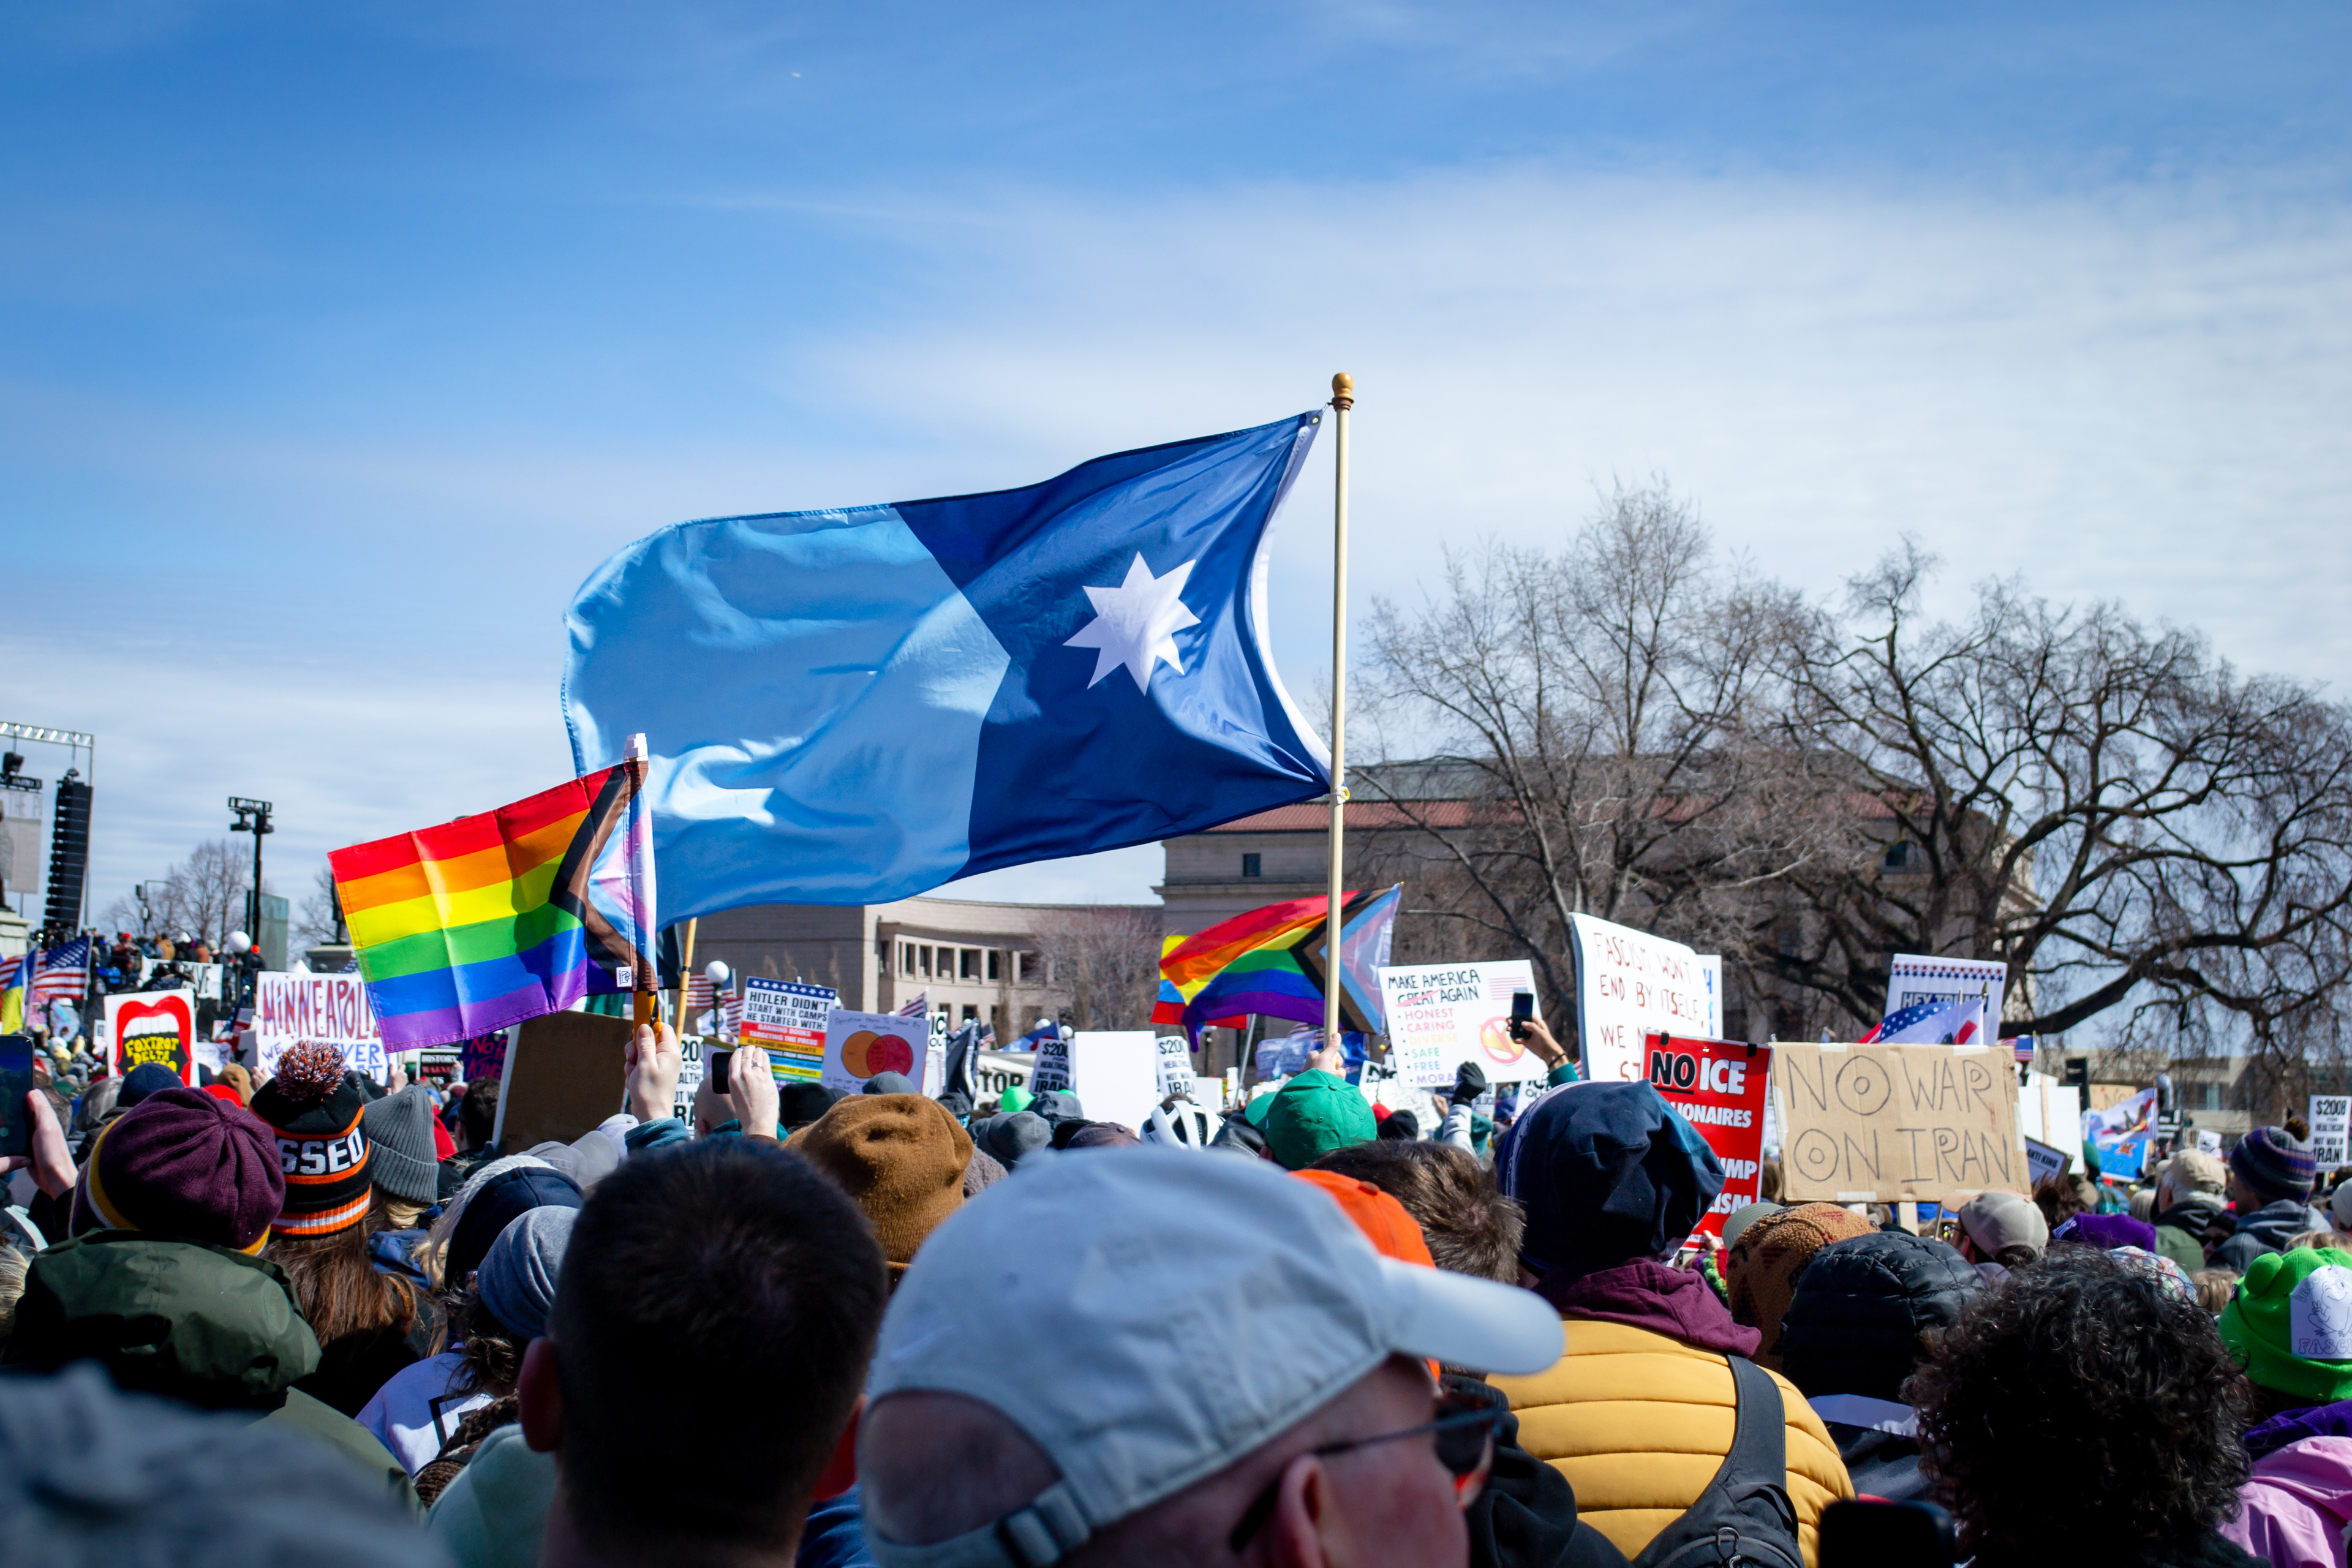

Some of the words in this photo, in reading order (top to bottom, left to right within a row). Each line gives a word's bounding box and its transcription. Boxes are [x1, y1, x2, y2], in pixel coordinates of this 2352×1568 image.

[1594, 932, 1651, 971] FASCISM
[1389, 975, 1419, 989] MAKE
[1422, 969, 1481, 987] AMERICA
[750, 991, 788, 1006] HITLER
[792, 997, 829, 1012] DIDN'T
[1440, 985, 1479, 1003] AGAIN
[1600, 974, 1624, 1000] END
[1636, 982, 1653, 1009] BY
[1902, 992, 1933, 1009] HEY
[747, 1012, 757, 1021] HE
[760, 1014, 797, 1026] STARTED
[801, 1020, 825, 1030] WITH:
[748, 1003, 774, 1013] START
[776, 1006, 796, 1017] WITH
[799, 1010, 827, 1021] CAMPS
[1404, 1008, 1453, 1020] HONEST
[1407, 1020, 1455, 1032] CARING
[785, 1035, 796, 1043] THE
[797, 1037, 818, 1046] PRESS
[1409, 1033, 1459, 1045] DIVERSE
[1600, 1025, 1626, 1048] WE
[124, 1036, 179, 1058] FOXTROT
[262, 1042, 284, 1060] WE
[334, 1043, 380, 1063] VER
[1411, 1047, 1440, 1058] SAFE
[133, 1050, 170, 1065] DELTA
[1414, 1061, 1441, 1071] FREE
[979, 1069, 1023, 1094] TOP
[1651, 1050, 1696, 1087] NO
[1699, 1057, 1747, 1095] ICE
[1786, 1053, 1891, 1116] NO
[1902, 1057, 1995, 1114] WAR
[1670, 1101, 1753, 1129] IONAIRES
[1794, 1128, 1880, 1182] ON
[1896, 1127, 2010, 1184] IRAN
